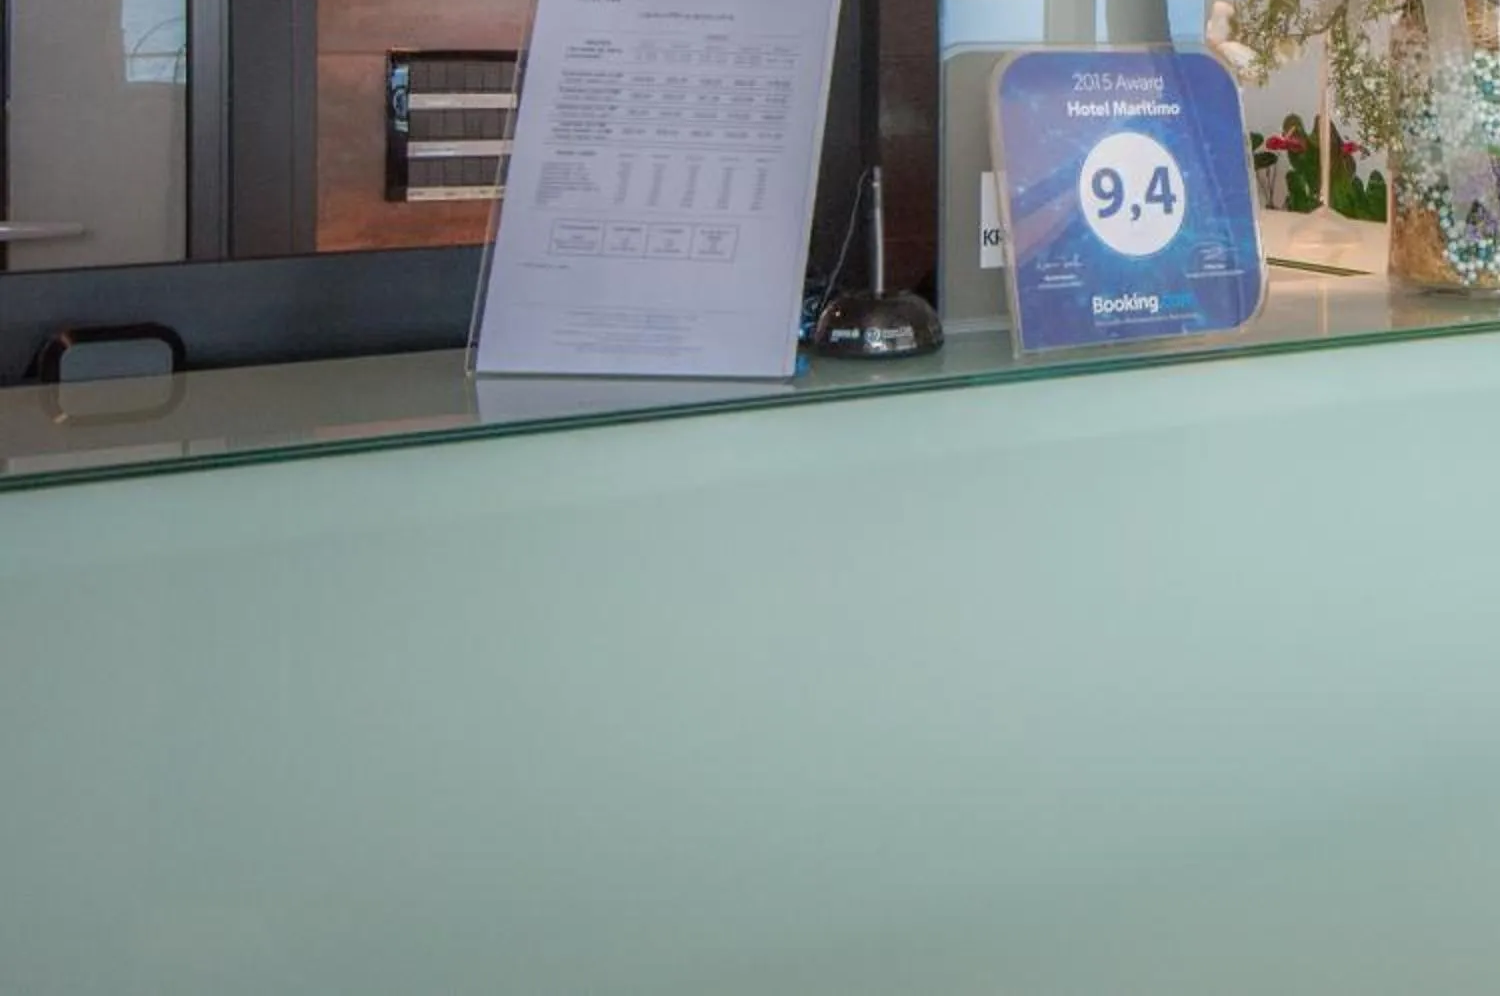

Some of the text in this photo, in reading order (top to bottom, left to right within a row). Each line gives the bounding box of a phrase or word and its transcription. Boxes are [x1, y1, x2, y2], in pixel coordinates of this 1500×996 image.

[1072, 73, 1165, 91] 2015 Award
[1066, 99, 1181, 117] Hotel Maritimo
[1092, 166, 1177, 220] 9,4
